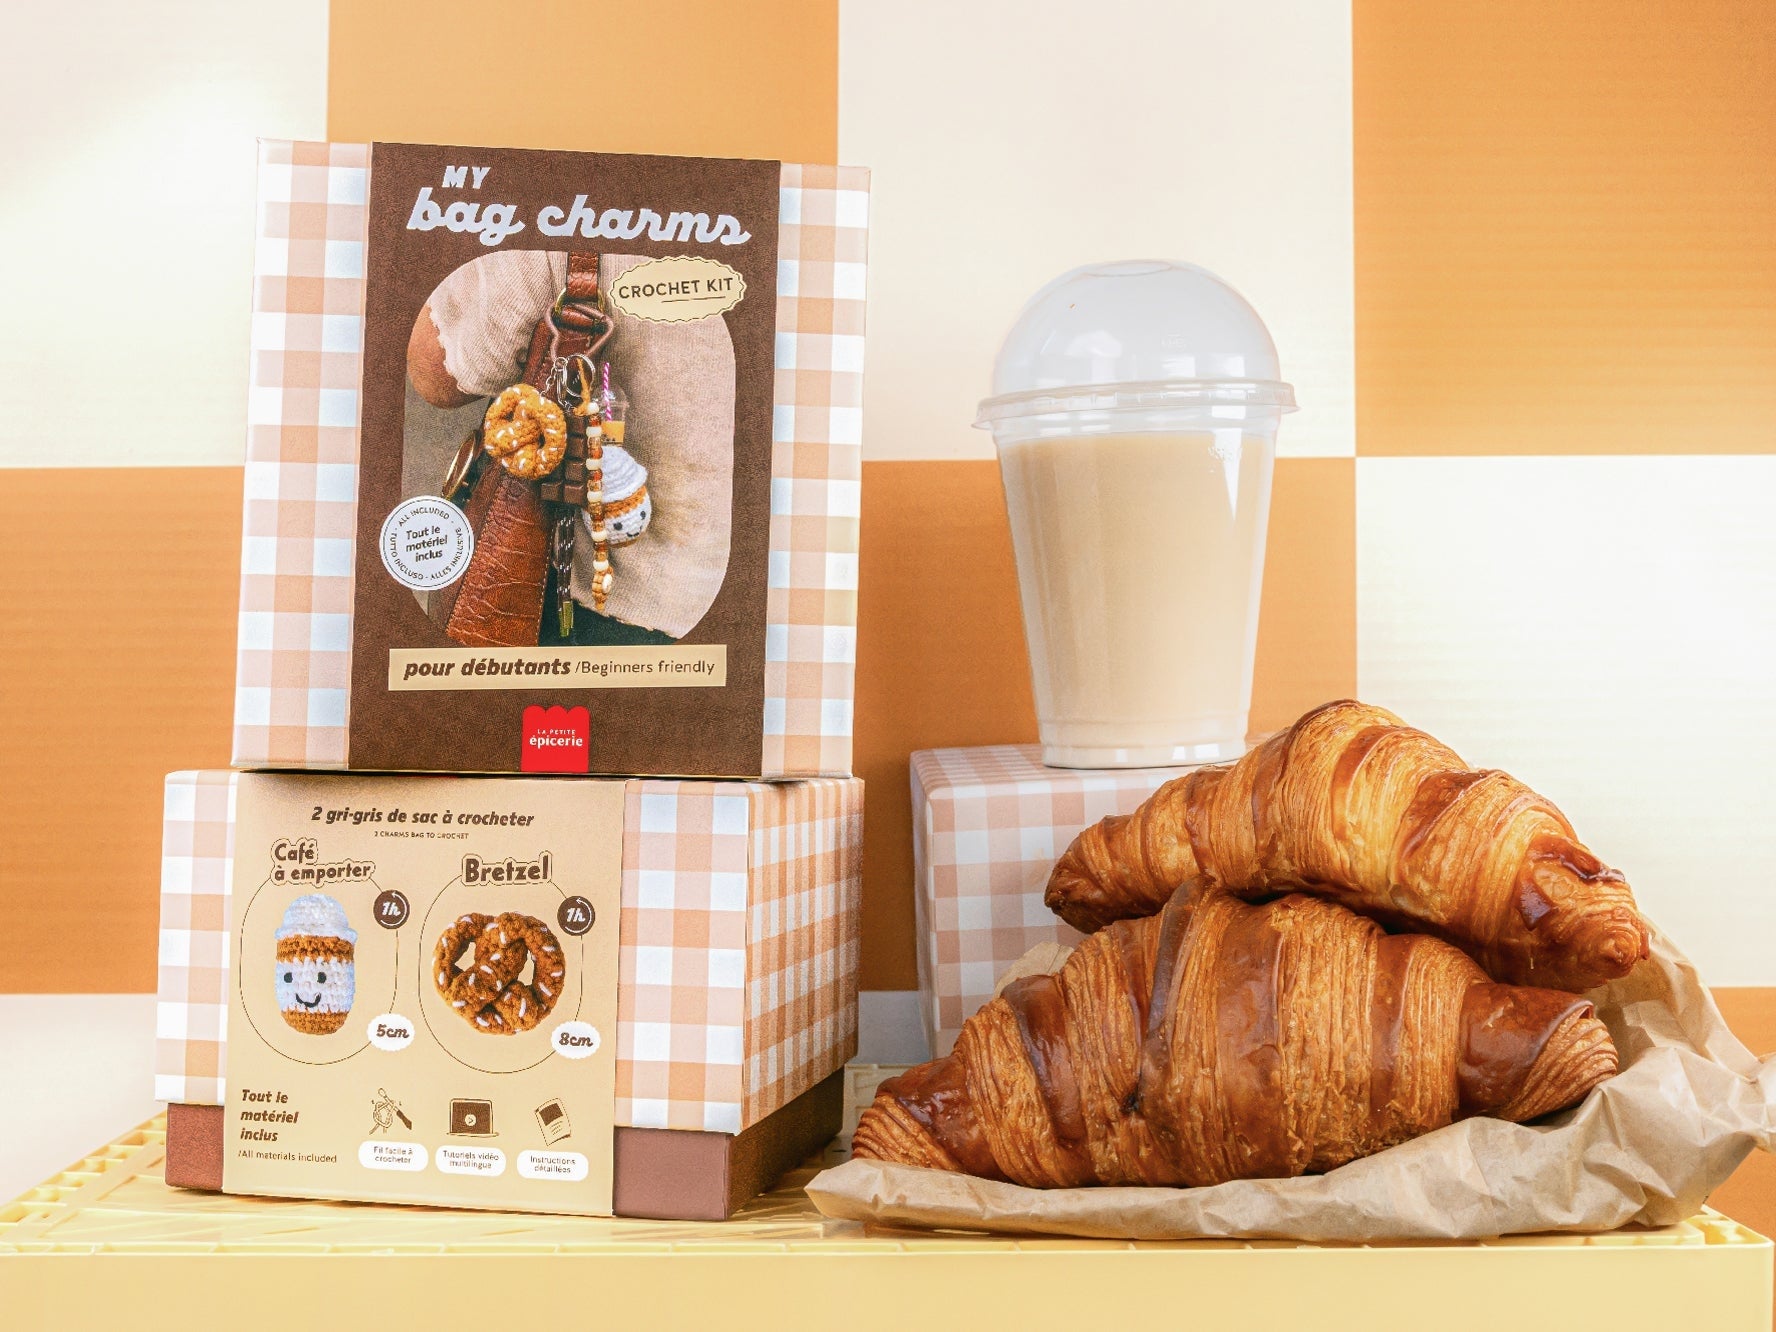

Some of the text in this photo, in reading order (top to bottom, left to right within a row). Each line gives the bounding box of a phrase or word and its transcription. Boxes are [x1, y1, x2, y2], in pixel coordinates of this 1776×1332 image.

[442, 165, 491, 190] MY
[406, 187, 752, 246] bag charms
[618, 277, 734, 299] CROCHET KIT
[398, 506, 450, 527] ALL INCLUDED
[405, 525, 441, 540] Tout le
[405, 534, 448, 553] matériel
[389, 532, 424, 580] TUTTO INCLUSO
[415, 549, 443, 562] inclus
[430, 565, 452, 580] ALLES
[403, 658, 715, 681] pour débutants /Beginners friendly
[529, 735, 583, 750] épicerie
[311, 806, 535, 827] 2 gri-gris de sac à crocheter
[379, 830, 410, 838] CHARMS
[274, 842, 315, 865] Café
[274, 863, 372, 884] à emporter
[465, 854, 549, 883] Bretzel
[381, 901, 402, 917] 1h
[566, 907, 586, 923] 1h
[376, 1023, 410, 1039] 5cm
[558, 1032, 594, 1048] 8cm
[242, 1088, 289, 1104] Tout le
[240, 1109, 300, 1124] matériel
[240, 1127, 279, 1142] inclus
[256, 1151, 296, 1161] materials
[298, 1152, 337, 1164] included
[385, 1146, 407, 1155] facile
[442, 1150, 500, 1161] Tutoriels vidéo
[375, 1155, 411, 1164] crocheter
[449, 1159, 492, 1170] multilingue
[530, 1155, 576, 1165] Instructions
[534, 1164, 571, 1173] détaillées
